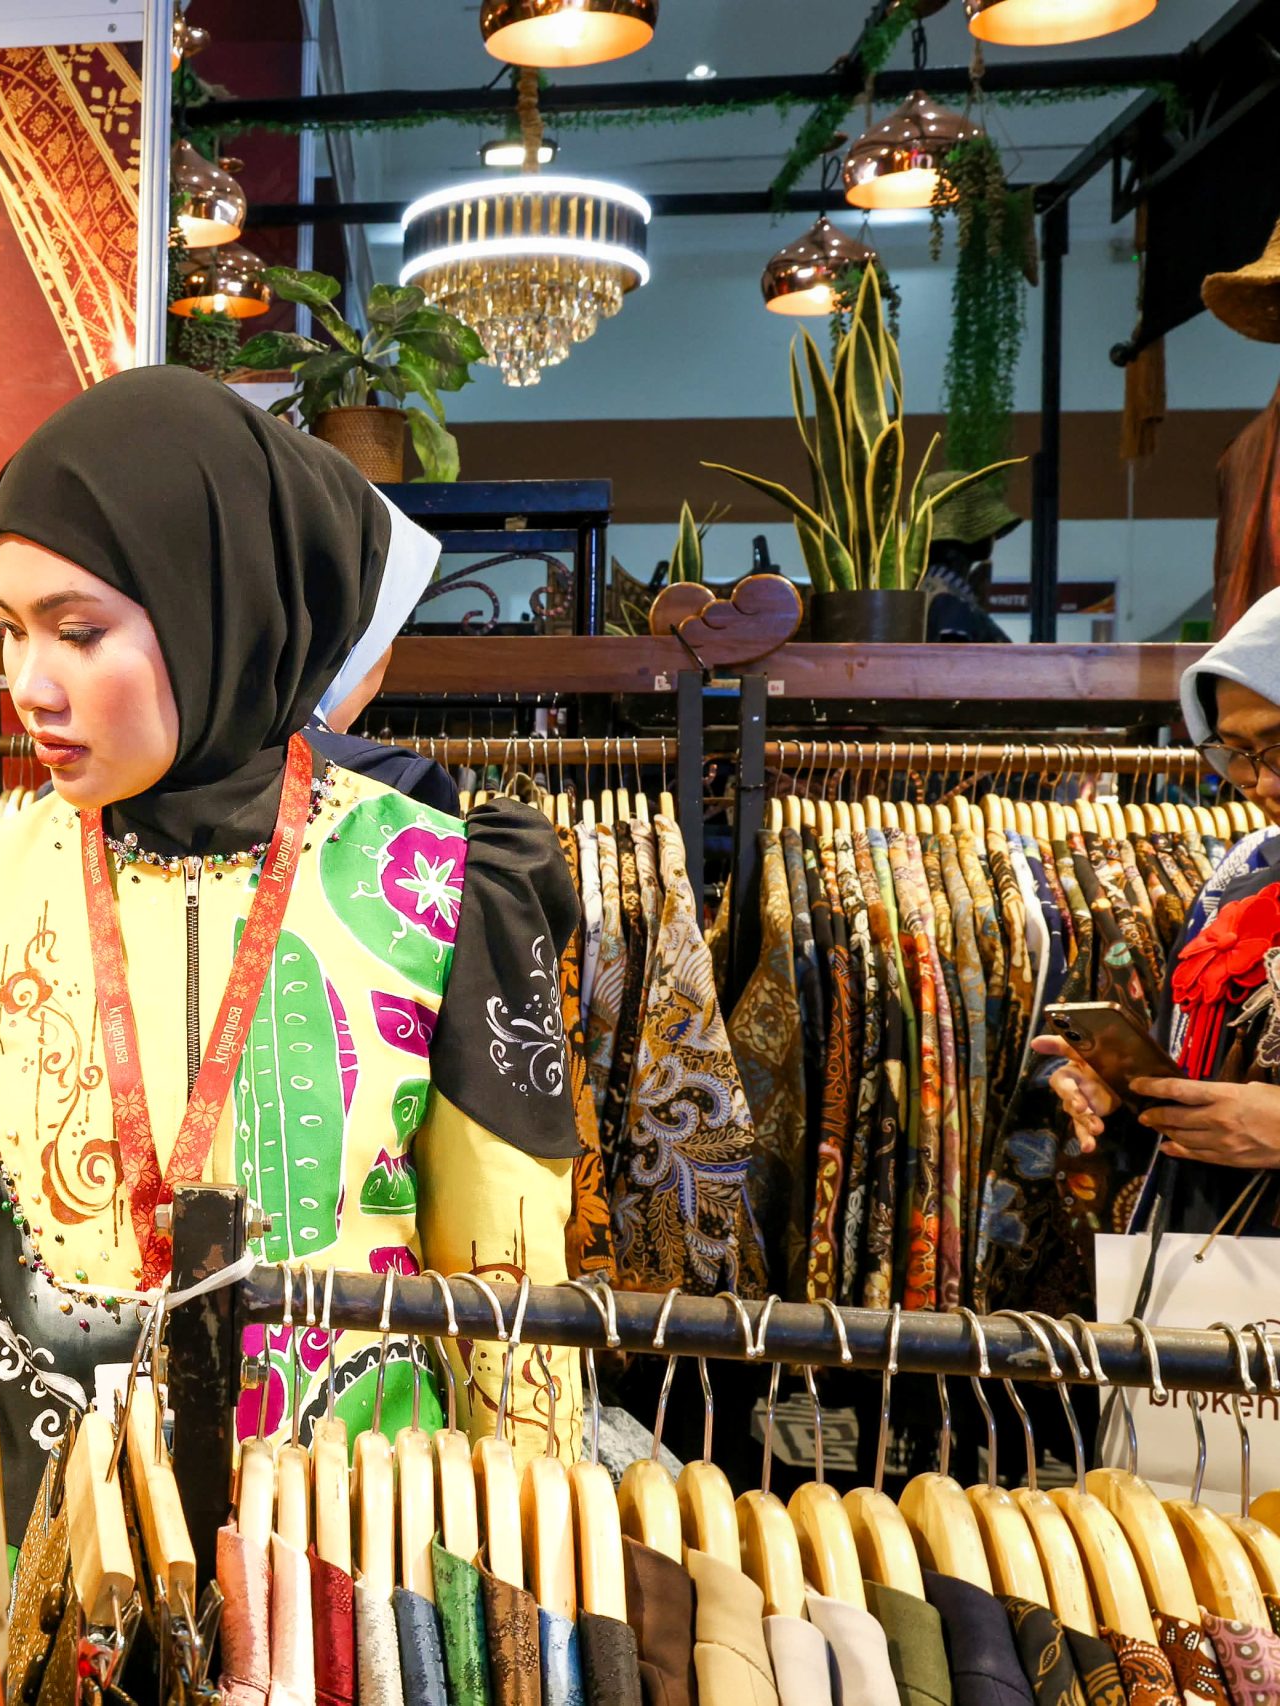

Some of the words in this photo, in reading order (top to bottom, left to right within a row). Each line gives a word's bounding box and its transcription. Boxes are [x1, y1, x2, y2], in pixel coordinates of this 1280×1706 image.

[84, 826, 101, 885] kriyanusa
[265, 827, 296, 891] kriyanusa
[104, 1000, 128, 1064] kriyanusa
[207, 1006, 243, 1073] kriyanusa
